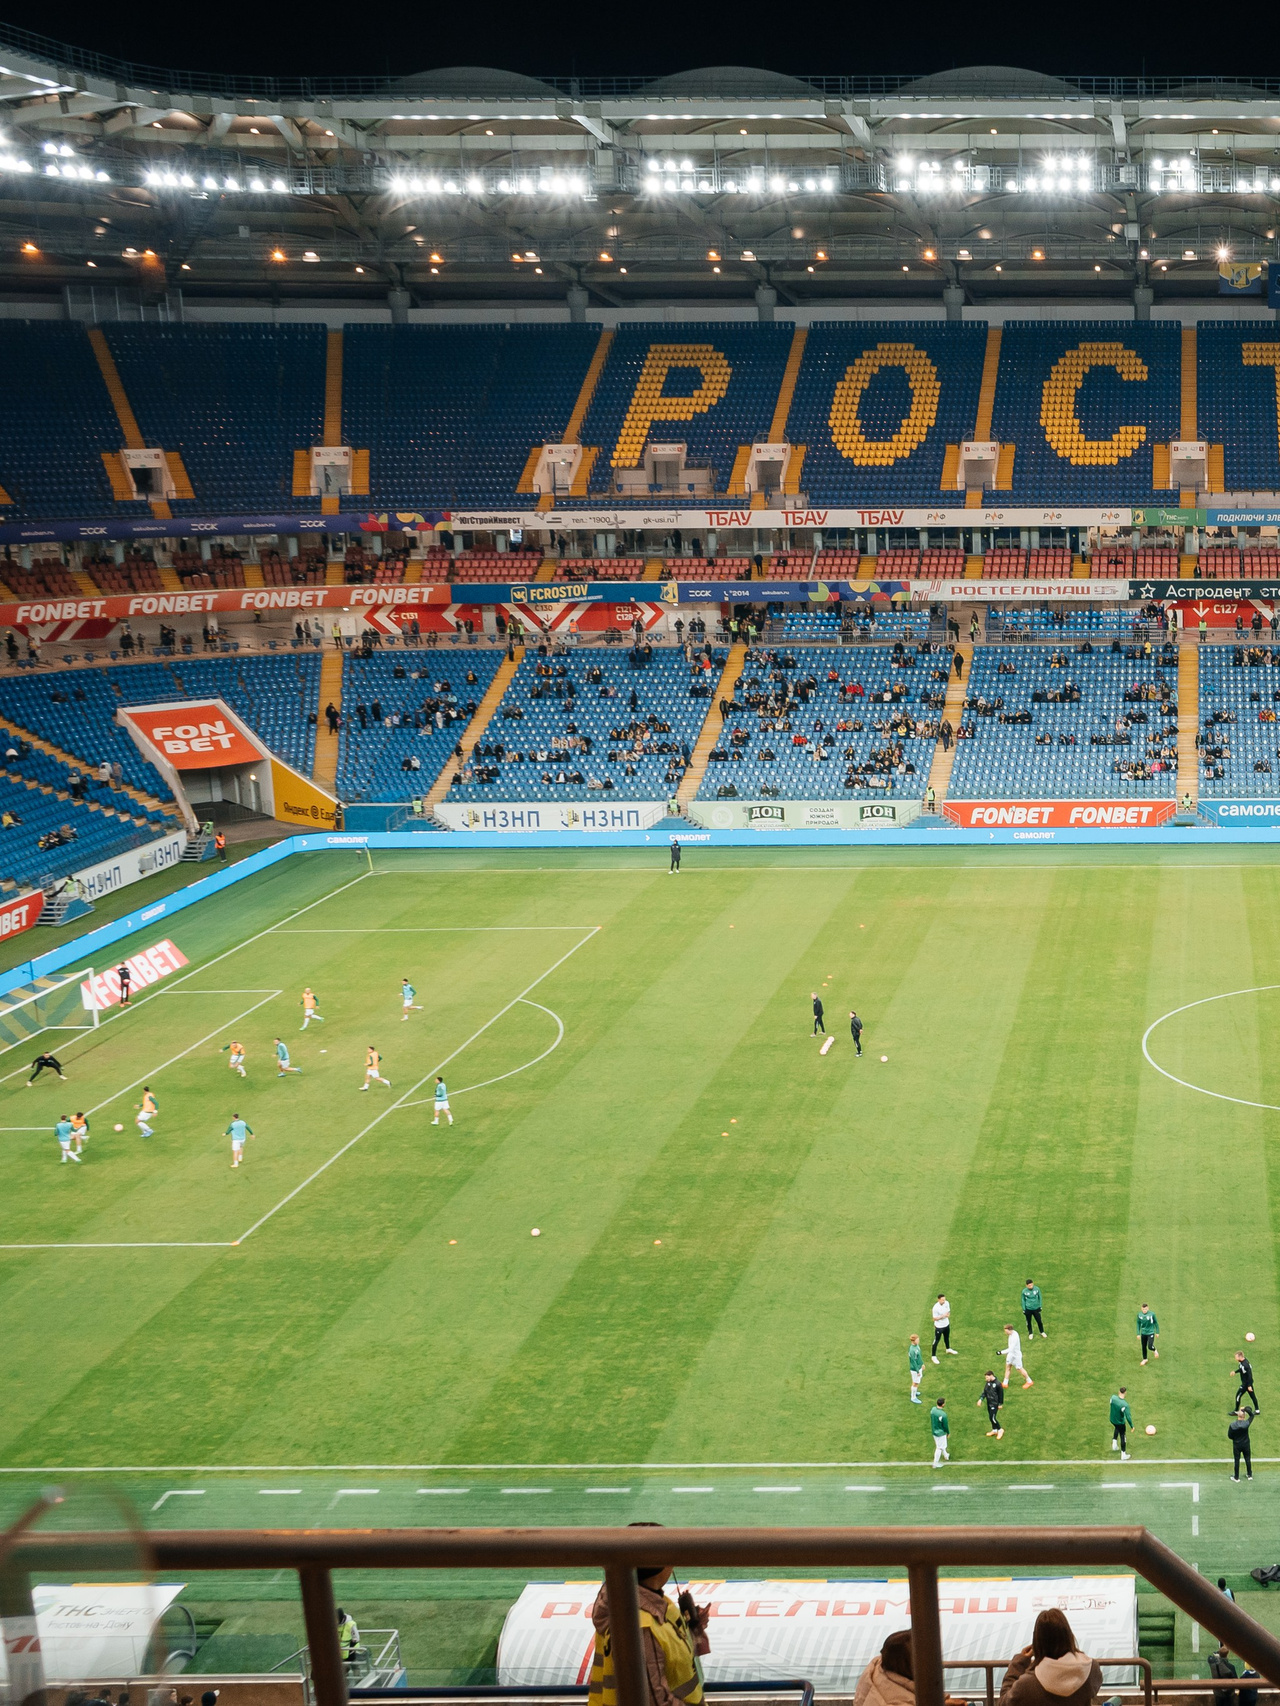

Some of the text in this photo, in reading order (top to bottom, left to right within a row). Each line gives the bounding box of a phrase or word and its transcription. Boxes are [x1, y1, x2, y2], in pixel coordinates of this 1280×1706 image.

[460, 516, 520, 525] ЮгСтройИнвест
[705, 511, 752, 526] ТБАУ
[781, 511, 828, 526] ТБАУ
[857, 510, 904, 525] ТБАУ
[1217, 514, 1264, 522] ПОДКЛЮЧИ
[350, 588, 434, 605] FONBET
[530, 584, 588, 601] FCROSTOV
[951, 586, 1090, 596] РОСТСЕЛЬМАШ
[1166, 585, 1250, 599] Астродент
[129, 594, 218, 615] FONBET
[241, 590, 328, 609] FONBET
[16, 601, 106, 623] FONBET
[535, 604, 553, 612] C130
[616, 606, 632, 614] C121
[1213, 604, 1238, 614] C127
[152, 720, 226, 740] FON
[163, 733, 235, 754] BET
[483, 810, 540, 828] НЗНП
[583, 810, 639, 828] НЗНП
[752, 807, 782, 818] ДОН
[863, 806, 893, 818] ДОН
[971, 807, 1054, 824] FONBET
[1069, 807, 1153, 824] FONBET
[669, 833, 711, 841] самолет
[1014, 831, 1055, 839] самолет
[93, 940, 181, 1009] FONBET
[54, 1605, 104, 1616] ТНС
